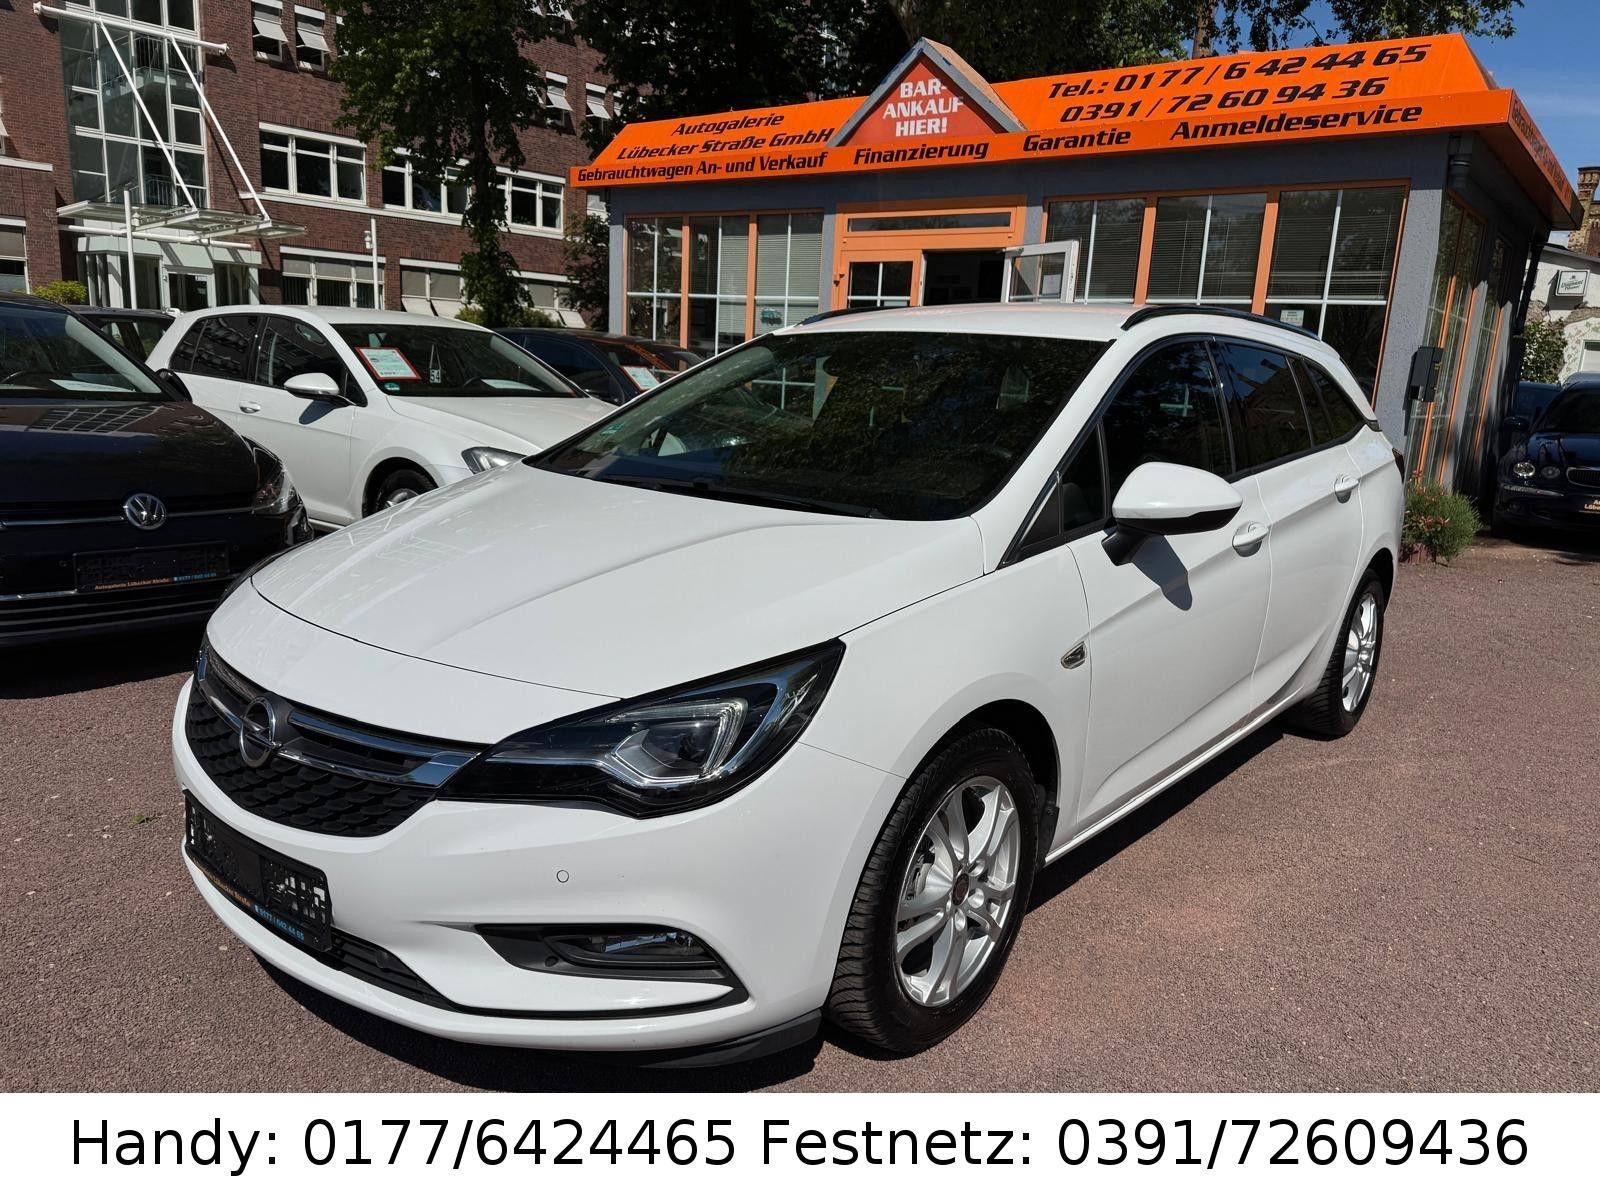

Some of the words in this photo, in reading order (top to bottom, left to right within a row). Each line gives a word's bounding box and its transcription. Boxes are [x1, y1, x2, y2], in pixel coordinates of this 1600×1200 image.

[900, 78, 948, 99] BAR-
[1048, 79, 1109, 98] Tel.:
[882, 96, 964, 119] ANKAUF
[1060, 100, 1142, 122] 0391
[671, 112, 784, 137] Autogalerie
[895, 117, 948, 137] HIER!
[1170, 104, 1423, 141] Anmeldeservice
[617, 142, 701, 160] Lübecker
[699, 136, 766, 154] Straße
[769, 127, 835, 147] GmbH
[1022, 127, 1132, 152] Garantie
[853, 142, 989, 165] Finanzierung
[578, 163, 693, 182] Gebrauchtwagen
[696, 160, 723, 175] An-
[725, 156, 754, 173] und
[759, 151, 828, 171] Verkauf
